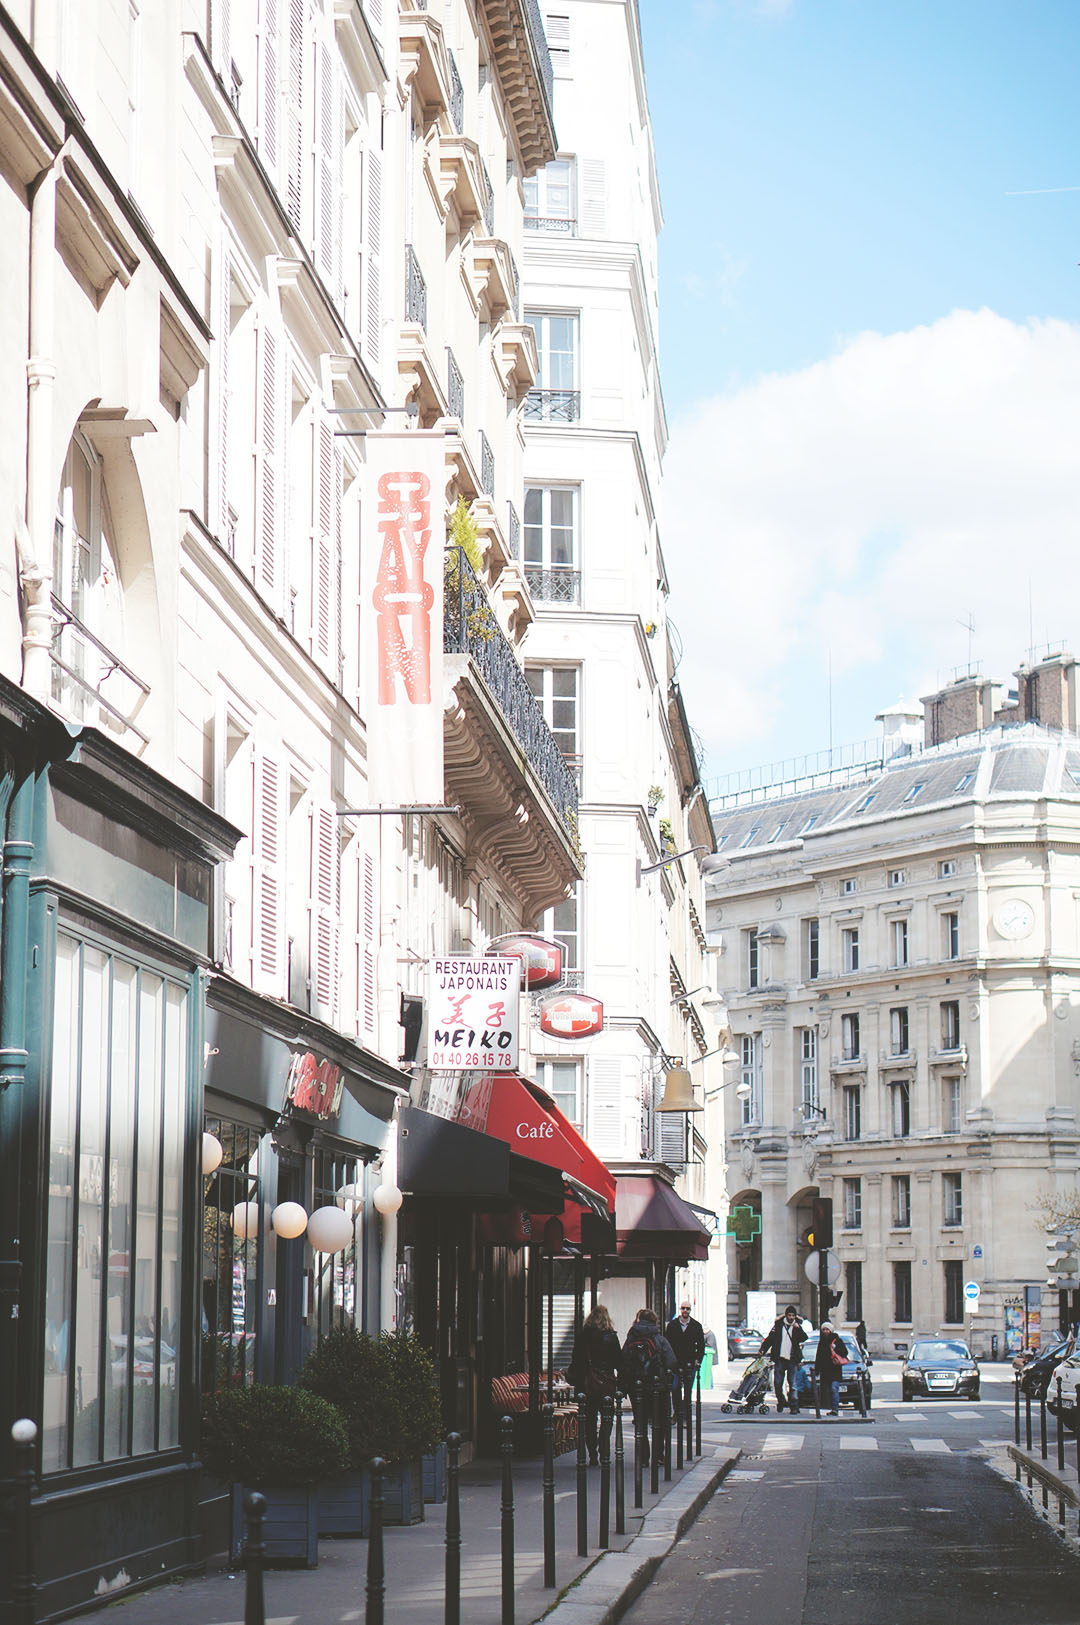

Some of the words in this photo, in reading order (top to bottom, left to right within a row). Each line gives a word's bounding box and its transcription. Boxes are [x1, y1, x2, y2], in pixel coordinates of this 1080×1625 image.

[372, 471, 434, 705] CRAYON
[435, 961, 513, 976] RESTAURANT
[440, 977, 507, 990] JAPONAIS
[434, 1029, 512, 1049] MEIKO
[433, 1052, 444, 1065] 01
[448, 1052, 462, 1065] 40
[465, 1053, 479, 1065] 26
[482, 1053, 494, 1066] 15
[498, 1053, 511, 1066] 78
[516, 1122, 554, 1139] Café
